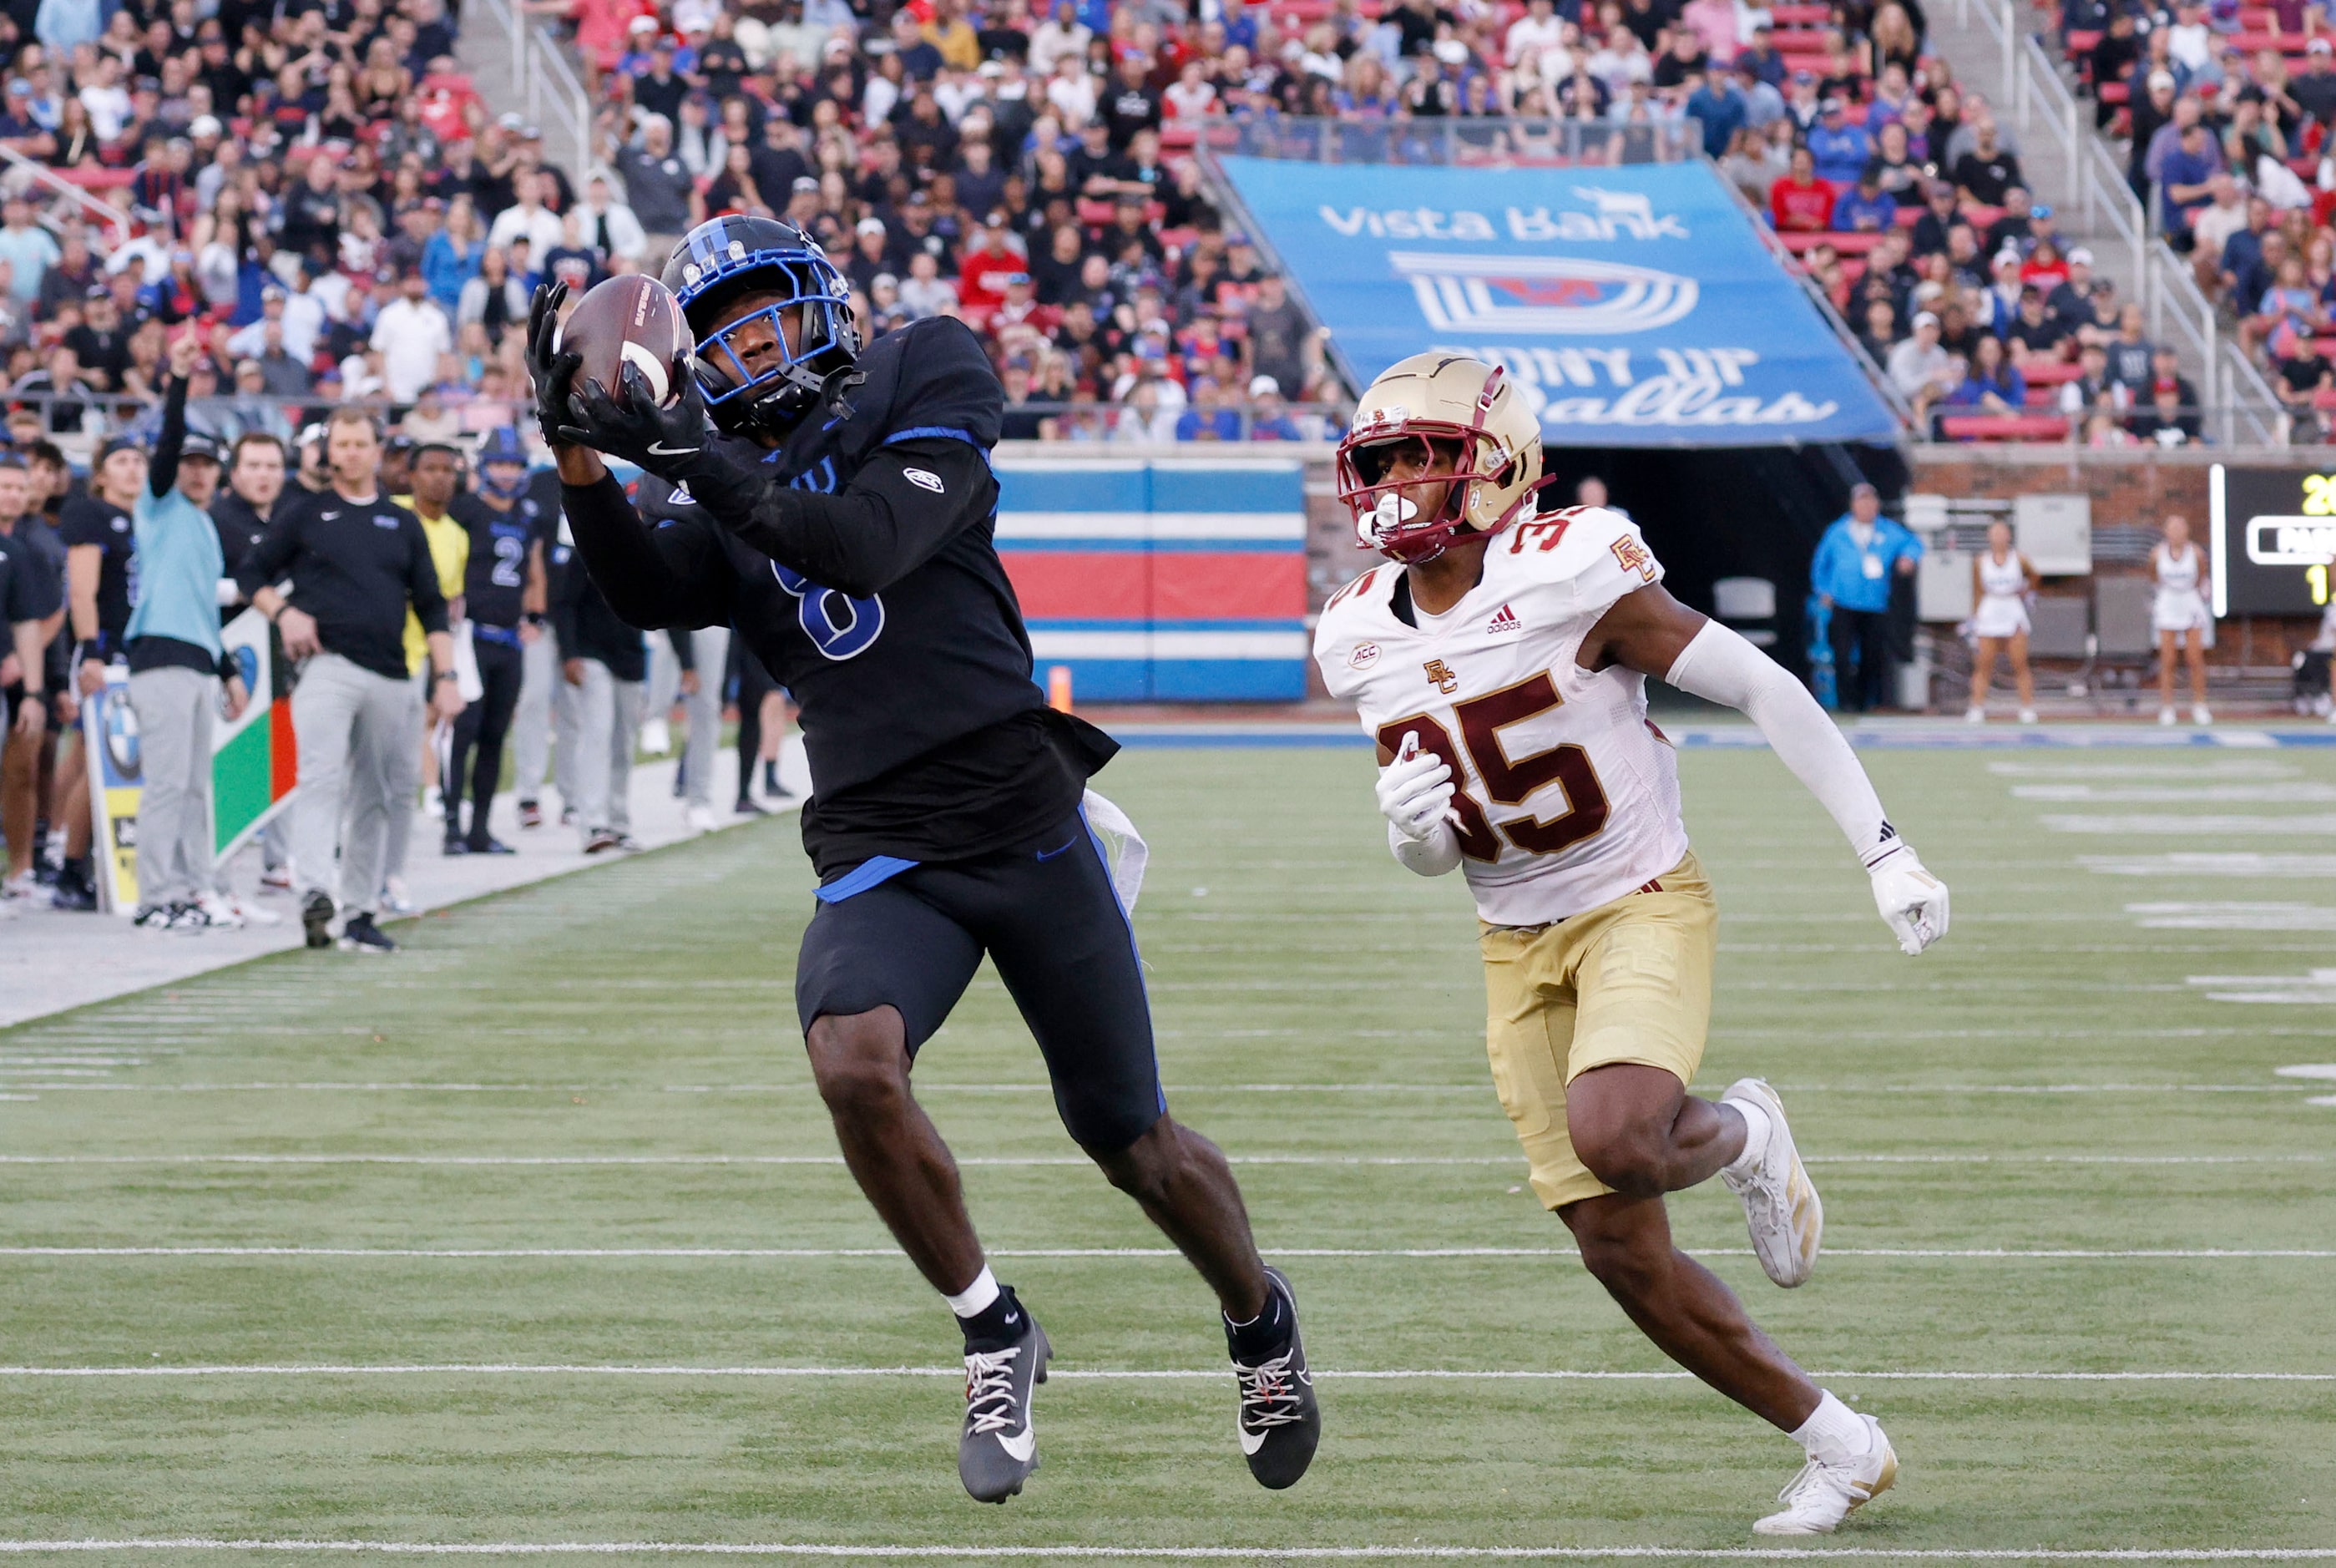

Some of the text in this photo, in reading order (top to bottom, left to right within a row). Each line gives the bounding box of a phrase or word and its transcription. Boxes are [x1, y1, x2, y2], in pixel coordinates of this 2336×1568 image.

[1319, 205, 1690, 240] Vista Bank
[2302, 474, 2336, 516] 2
[491, 536, 523, 587] 2
[1487, 620, 1522, 635] adidas
[1353, 645, 1377, 662] ACC
